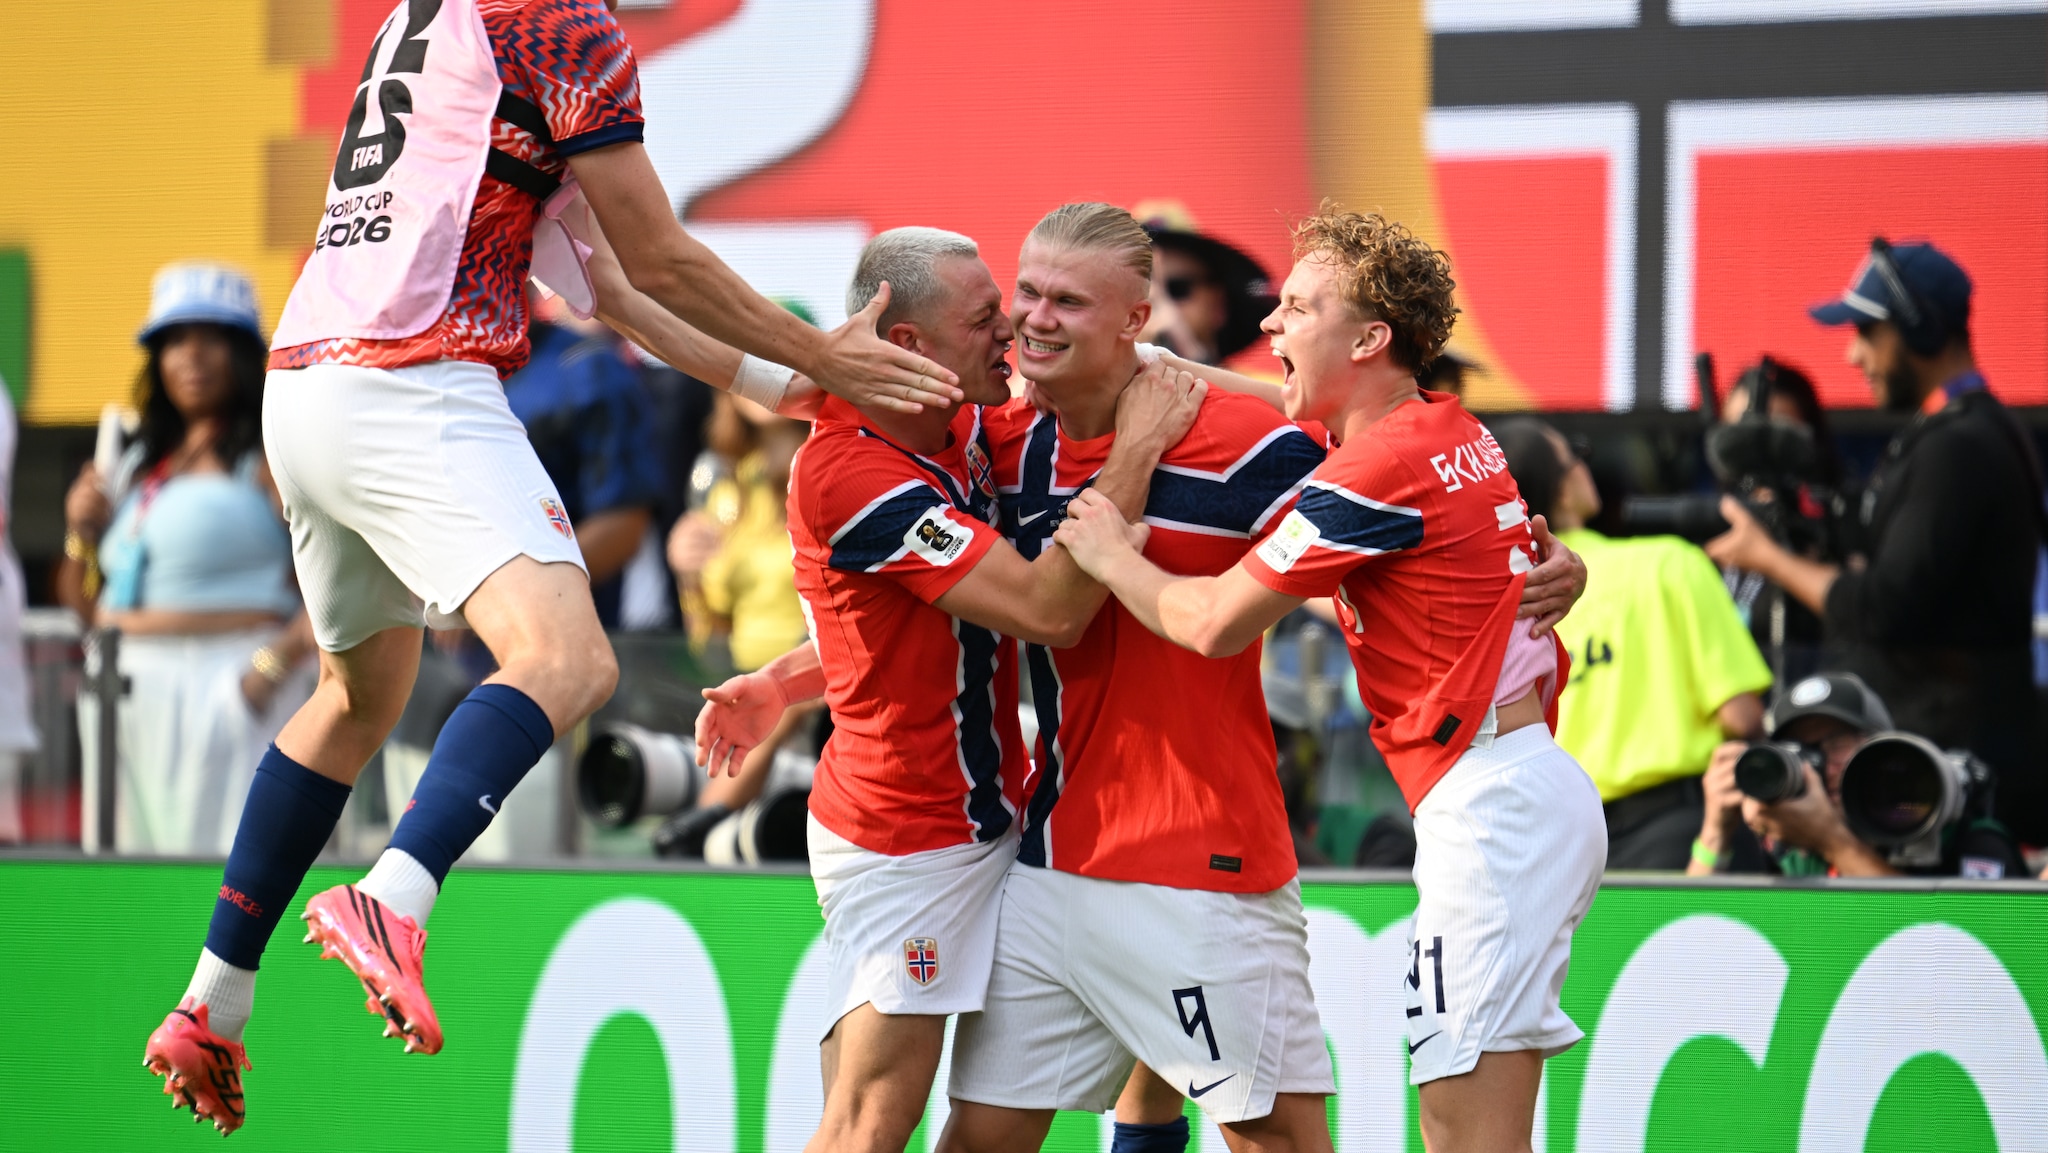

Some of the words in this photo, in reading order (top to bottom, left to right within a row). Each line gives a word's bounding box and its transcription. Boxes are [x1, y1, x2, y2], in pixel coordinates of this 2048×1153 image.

[350, 143, 383, 172] FIFA
[365, 191, 393, 212] CUP
[316, 215, 392, 254] 2026
[947, 539, 964, 559] 2026
[1172, 985, 1221, 1062] 9
